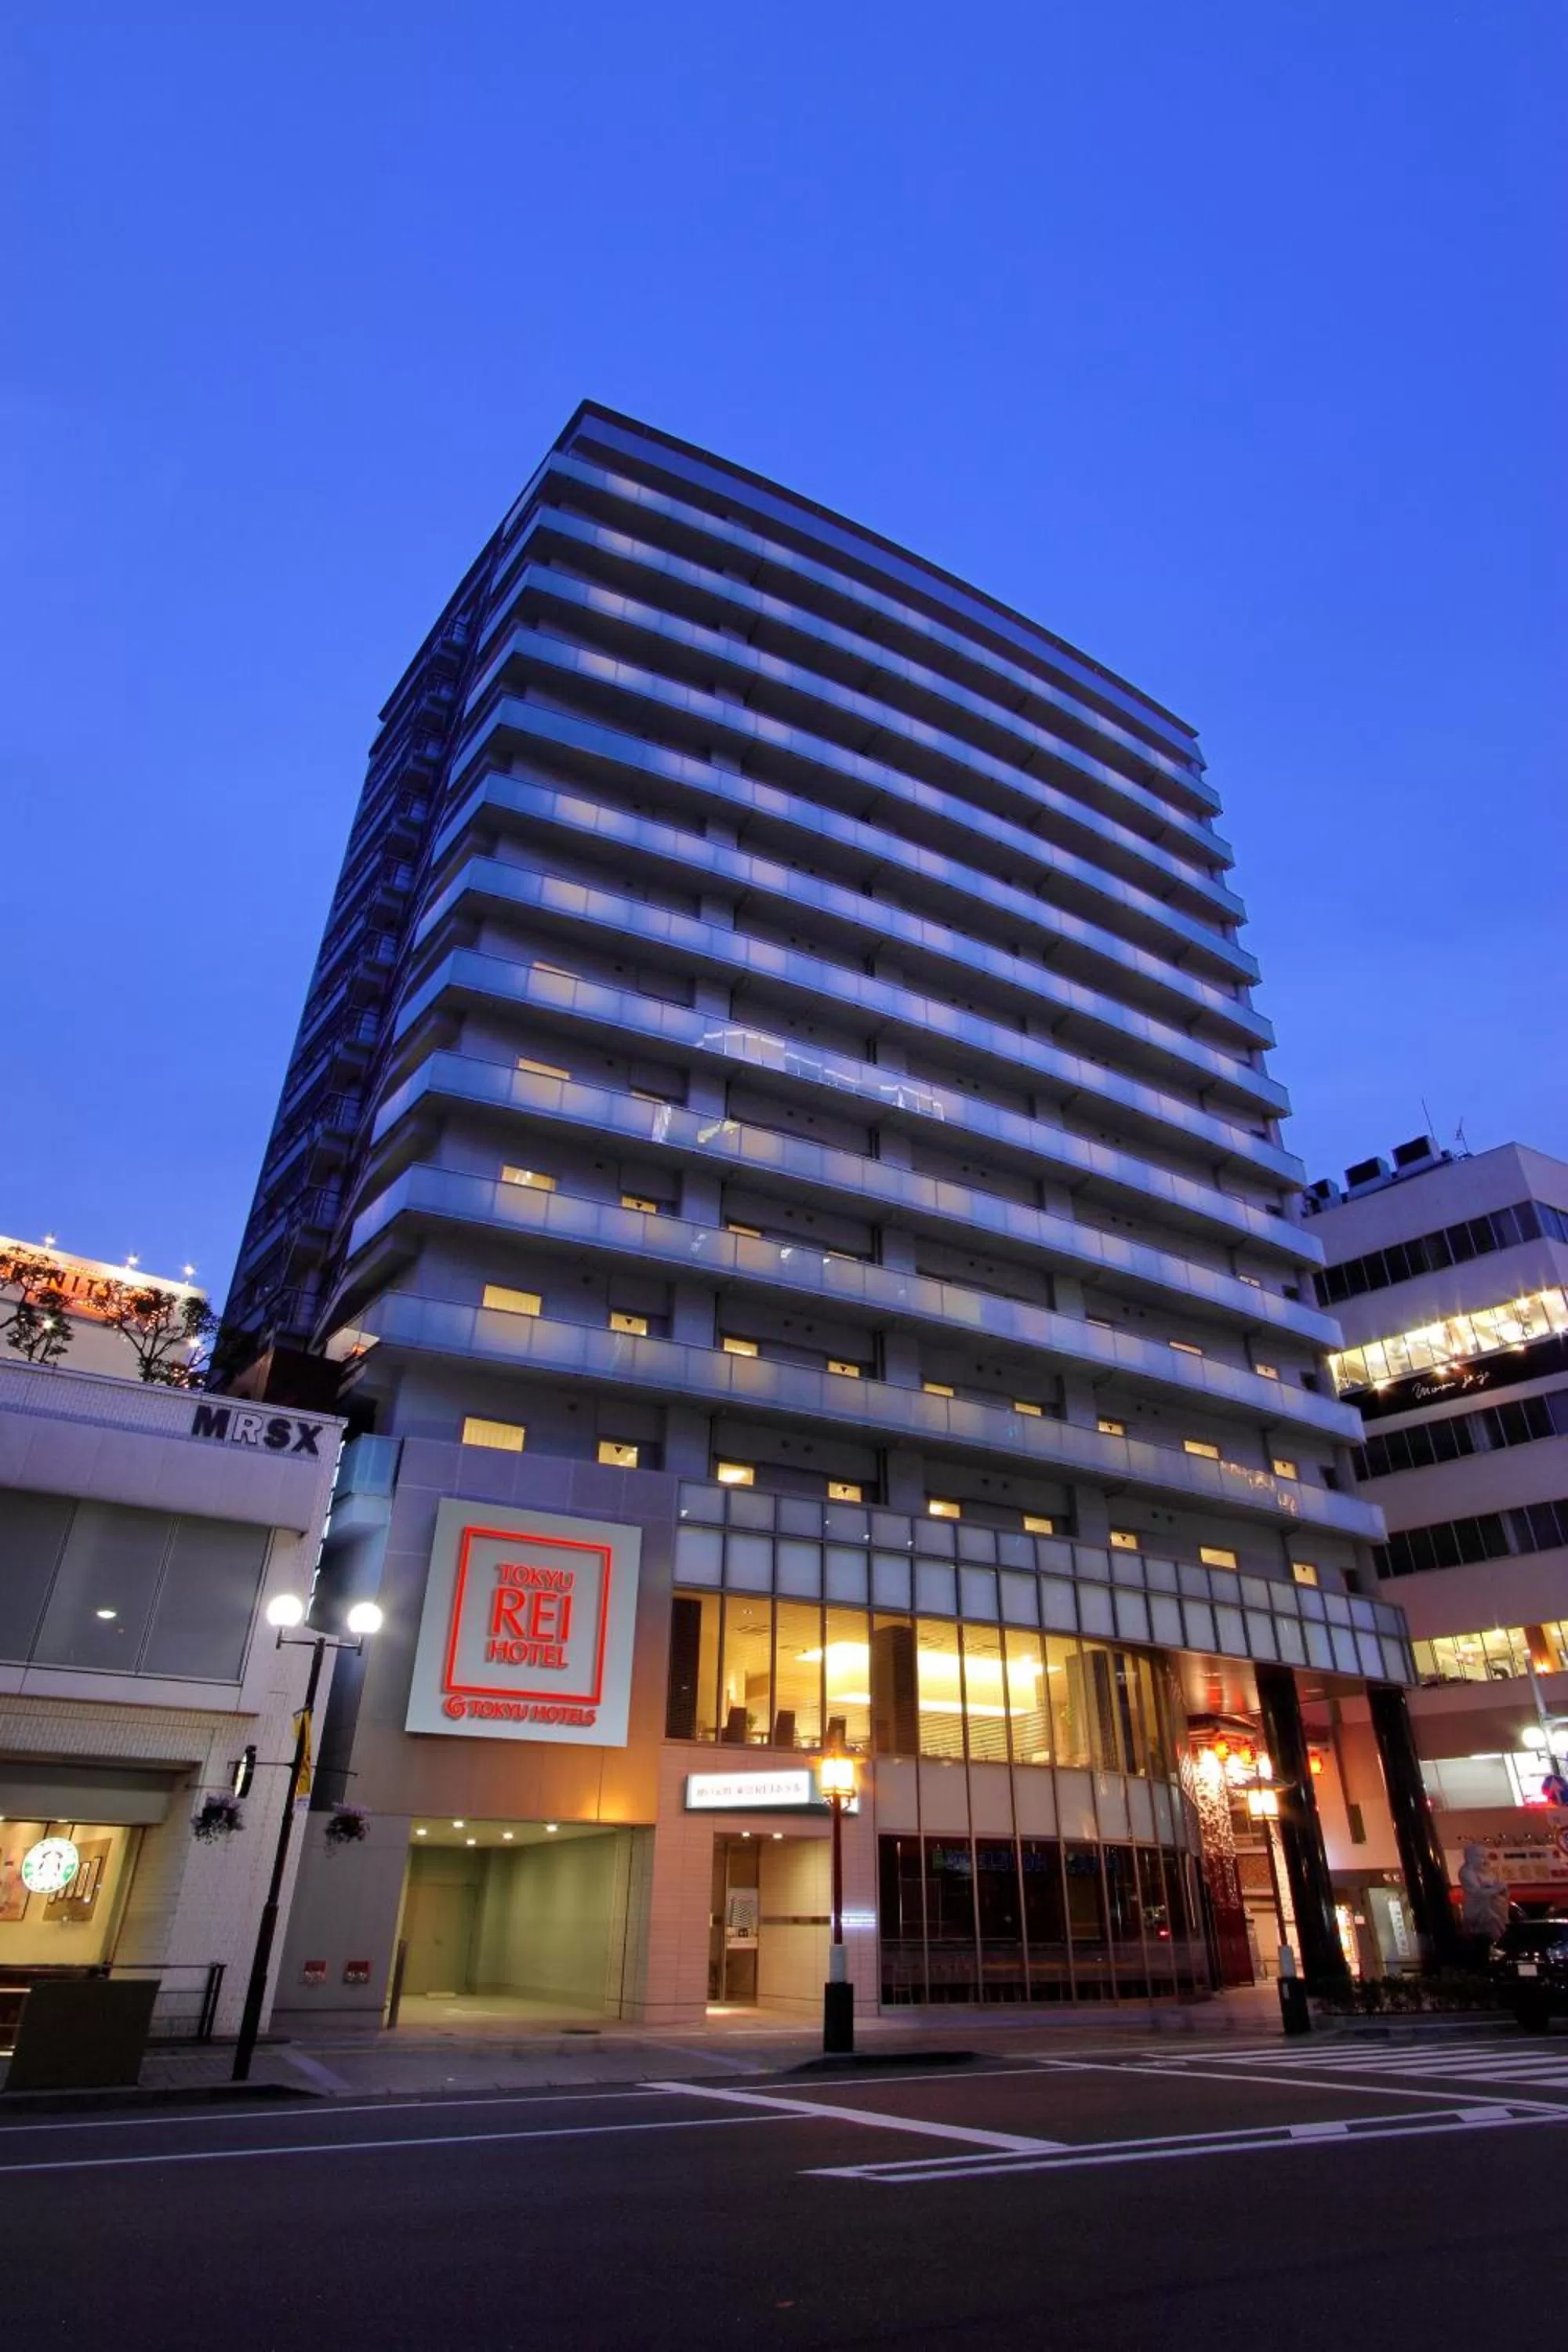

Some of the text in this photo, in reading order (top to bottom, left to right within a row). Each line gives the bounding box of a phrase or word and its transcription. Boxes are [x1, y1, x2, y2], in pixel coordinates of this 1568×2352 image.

[191, 1404, 323, 1456] MRSX
[497, 1563, 574, 1590] TOKYU
[491, 1586, 572, 1642] REI
[487, 1639, 568, 1670] HOTEL
[471, 1698, 596, 1727] TOKYU HOTELS
